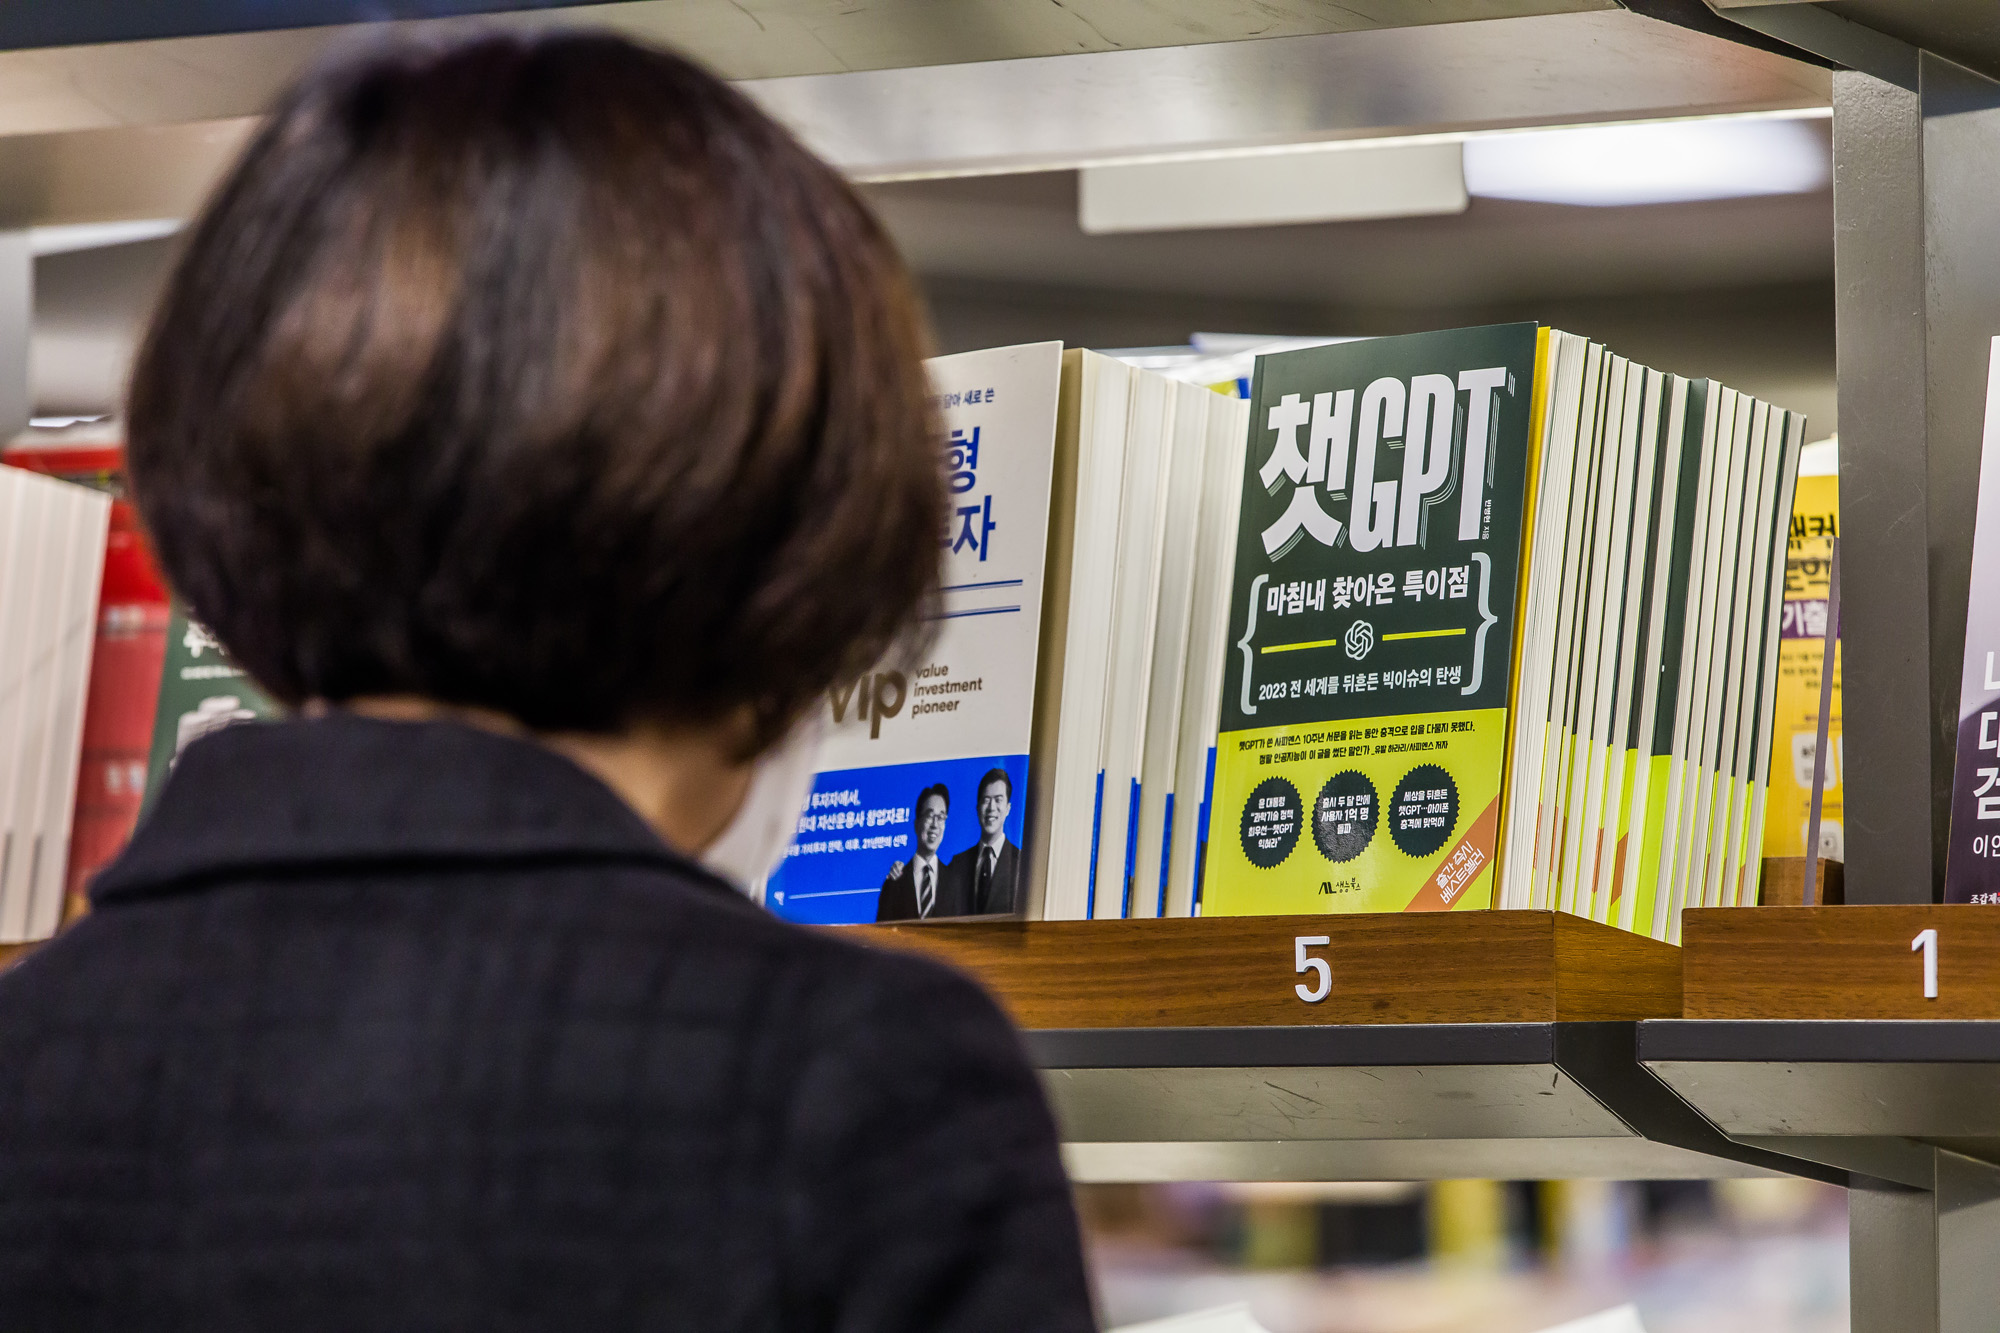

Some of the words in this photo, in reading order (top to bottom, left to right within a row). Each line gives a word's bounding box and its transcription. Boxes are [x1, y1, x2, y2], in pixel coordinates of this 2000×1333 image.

[985, 388, 995, 403] 쓴
[1258, 366, 1513, 560] 챗GPT
[1482, 525, 1490, 540] 지음
[1266, 578, 1327, 616] 마침내
[1332, 572, 1396, 609] 찾아온
[1402, 565, 1470, 602] 특이점
[915, 663, 949, 679] value
[913, 678, 983, 697] investment
[1258, 682, 1287, 700] 2023
[1290, 679, 1302, 698] 전
[1304, 675, 1340, 696] 세계를
[1343, 672, 1379, 693] 뒤흔든
[1382, 667, 1432, 690] 빅이슈의
[1436, 665, 1462, 685] 탄생
[911, 699, 960, 719] pioneer
[1239, 738, 1266, 751] 챗GPT가
[1266, 738, 1273, 748] 쓴
[1274, 734, 1301, 747] 사피엔스
[1303, 732, 1325, 744] 10주년
[1326, 730, 1347, 742] 서문을
[1349, 729, 1363, 741] 읽는
[1365, 728, 1379, 739] 동안
[1380, 725, 1409, 737] 충격으로
[1410, 724, 1425, 735] 입을
[1427, 722, 1449, 734] 다물지
[1450, 721, 1476, 733] 못했다.
[1259, 753, 1272, 765] 정말
[1274, 750, 1307, 764] 인공지능이
[1309, 749, 1316, 760] 이
[1317, 748, 1331, 759] 글을
[1332, 746, 1347, 758] 썼단
[1348, 744, 1370, 757] 말인가
[1435, 740, 1449, 750] 저자
[1265, 796, 1286, 809] 대통령
[1322, 796, 1337, 809] 출시
[1337, 796, 1346, 807] 두
[1346, 795, 1355, 807] 달
[1355, 794, 1371, 806] 만에
[1403, 790, 1425, 802] 세상을
[1426, 788, 1448, 800] 뒤흔든
[1280, 809, 1294, 821] 정책
[1321, 809, 1343, 822] 사용자
[1344, 807, 1358, 822] 1억
[1359, 807, 1369, 821] 명
[1400, 818, 1422, 830] 충격에
[1423, 816, 1445, 829] 맞먹어
[1337, 822, 1352, 835] 돌파
[1435, 862, 1457, 889] 출간
[1452, 840, 1474, 866] 즉시
[1439, 848, 1485, 905] 베스트셀러
[1969, 892, 2000, 905] 조갑제
[1294, 935, 1332, 1003] 5
[1911, 928, 1938, 998] 1
